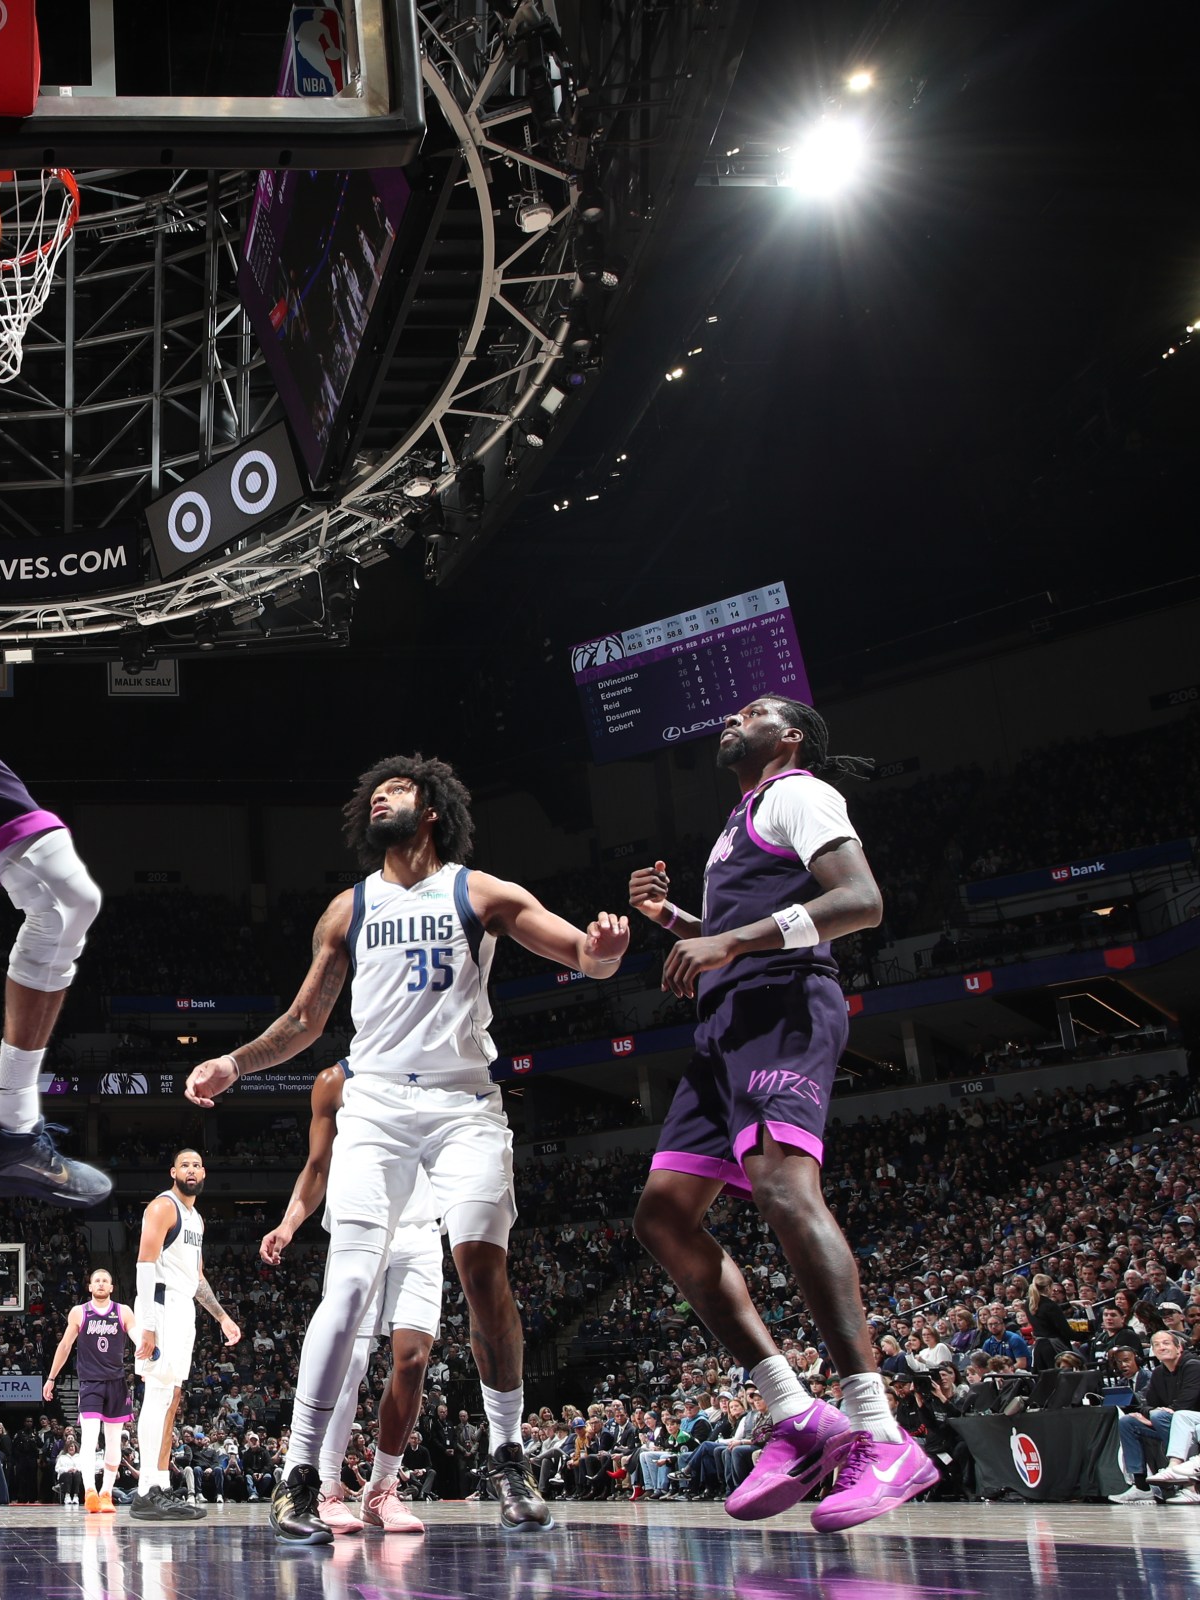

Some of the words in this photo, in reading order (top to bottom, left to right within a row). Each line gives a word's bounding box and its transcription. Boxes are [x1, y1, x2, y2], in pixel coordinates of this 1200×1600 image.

[302, 77, 327, 93] NBA
[706, 608, 718, 616] AST
[768, 588, 781, 596] BLK
[627, 641, 643, 651] 45.8
[646, 635, 662, 645] 37.9
[667, 629, 683, 639] 58.8
[690, 623, 699, 631] 39
[710, 617, 719, 625] 19
[730, 610, 740, 619] 14
[671, 645, 684, 653] PTS
[685, 641, 698, 649] REB
[701, 635, 713, 644] AST
[731, 622, 758, 634] FGM/A
[760, 614, 786, 626] 3PM/A
[598, 672, 639, 689] DiVincenzo
[770, 626, 785, 637] 3/4
[600, 686, 633, 700] Edwards
[773, 638, 788, 648] 3/9
[114, 678, 142, 686] MALIK
[145, 678, 172, 686] SEALY
[603, 701, 620, 711] Reid
[777, 650, 790, 660] 1/3
[605, 707, 641, 722] Dosunmu
[780, 661, 793, 671] 1/4
[608, 721, 634, 733] Gobert
[781, 673, 796, 683] 0/0
[147, 872, 168, 882] 202
[1052, 869, 1069, 880] us
[1070, 861, 1107, 877] bank
[366, 914, 454, 949] DALLAS
[405, 947, 454, 992] 35
[557, 973, 569, 983] us
[177, 1000, 189, 1008] us
[191, 999, 216, 1008] bank
[612, 1037, 633, 1053] us
[513, 1058, 531, 1070] us
[56, 1084, 61, 1092] 3
[72, 1084, 78, 1092] 4
[240, 1083, 277, 1092] remaining.
[961, 1081, 984, 1094] 106
[541, 1143, 558, 1154] 104
[86, 1319, 118, 1336] Wolves
